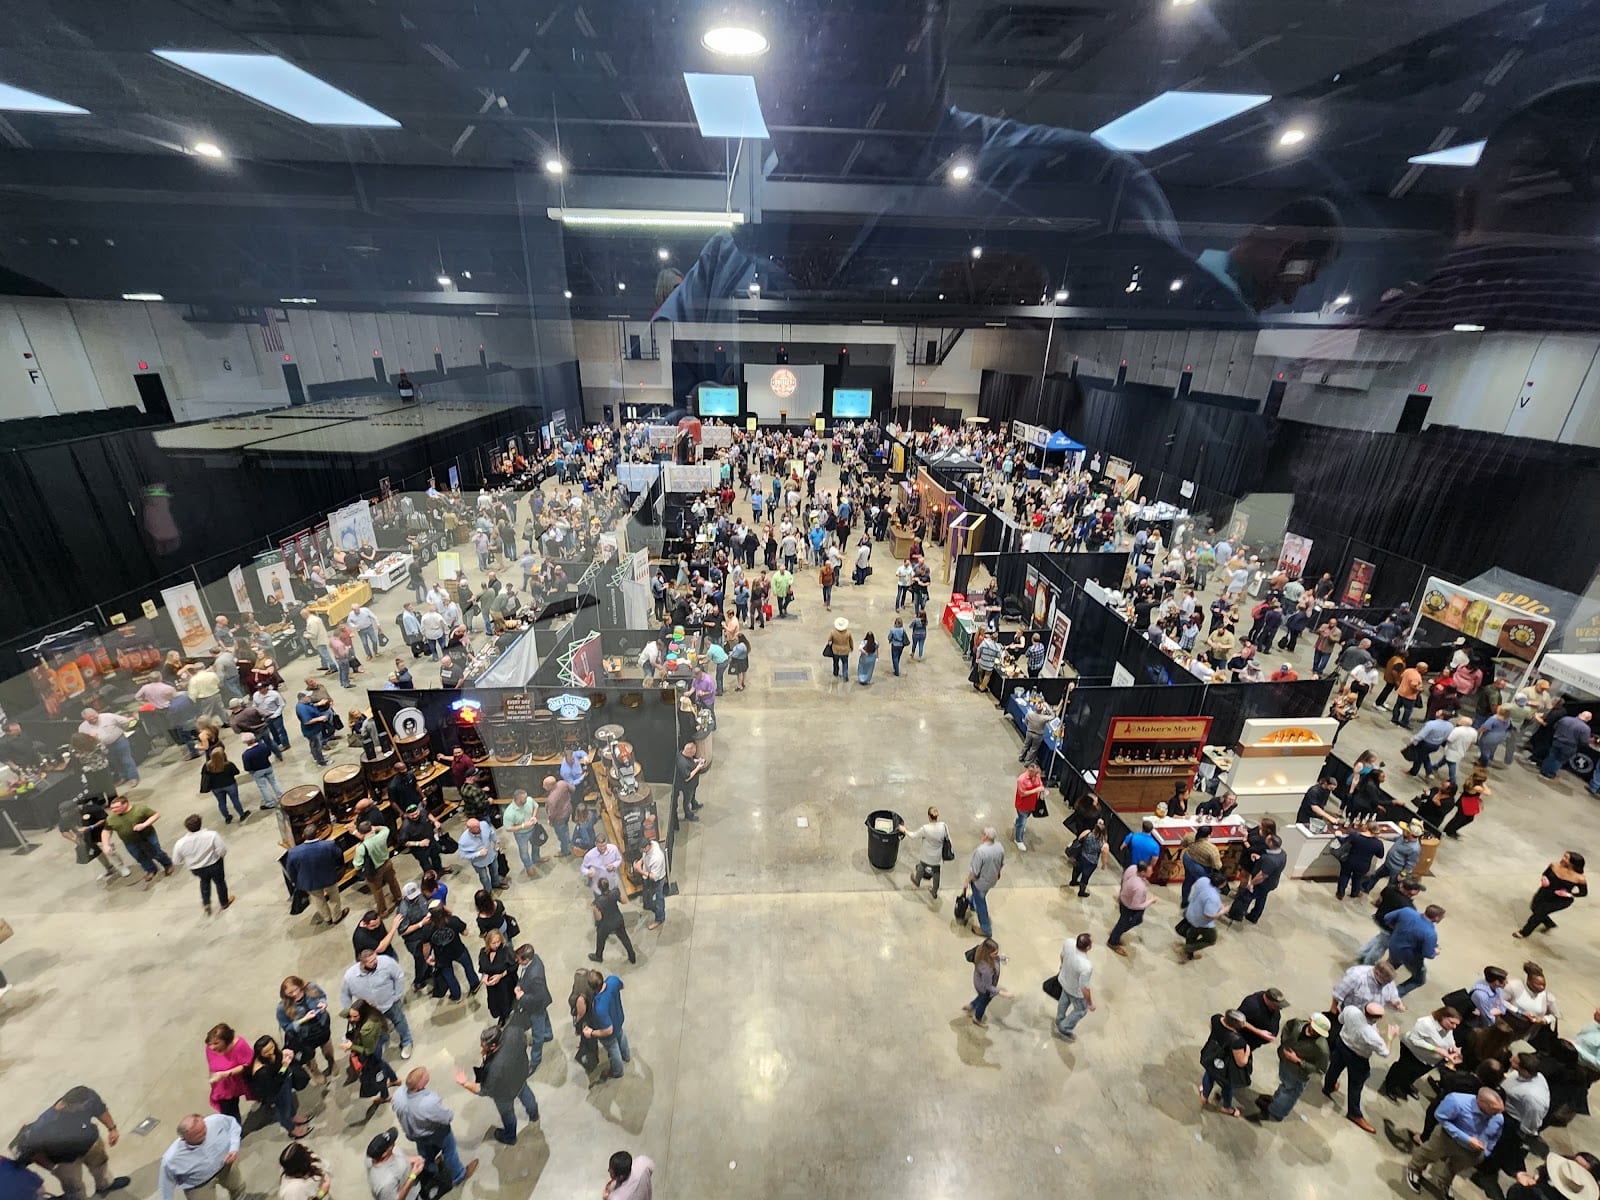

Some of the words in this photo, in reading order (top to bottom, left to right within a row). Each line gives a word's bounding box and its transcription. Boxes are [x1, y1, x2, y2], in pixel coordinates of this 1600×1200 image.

[223, 359, 232, 371] G
[28, 370, 40, 384] F
[1520, 396, 1531, 408] V
